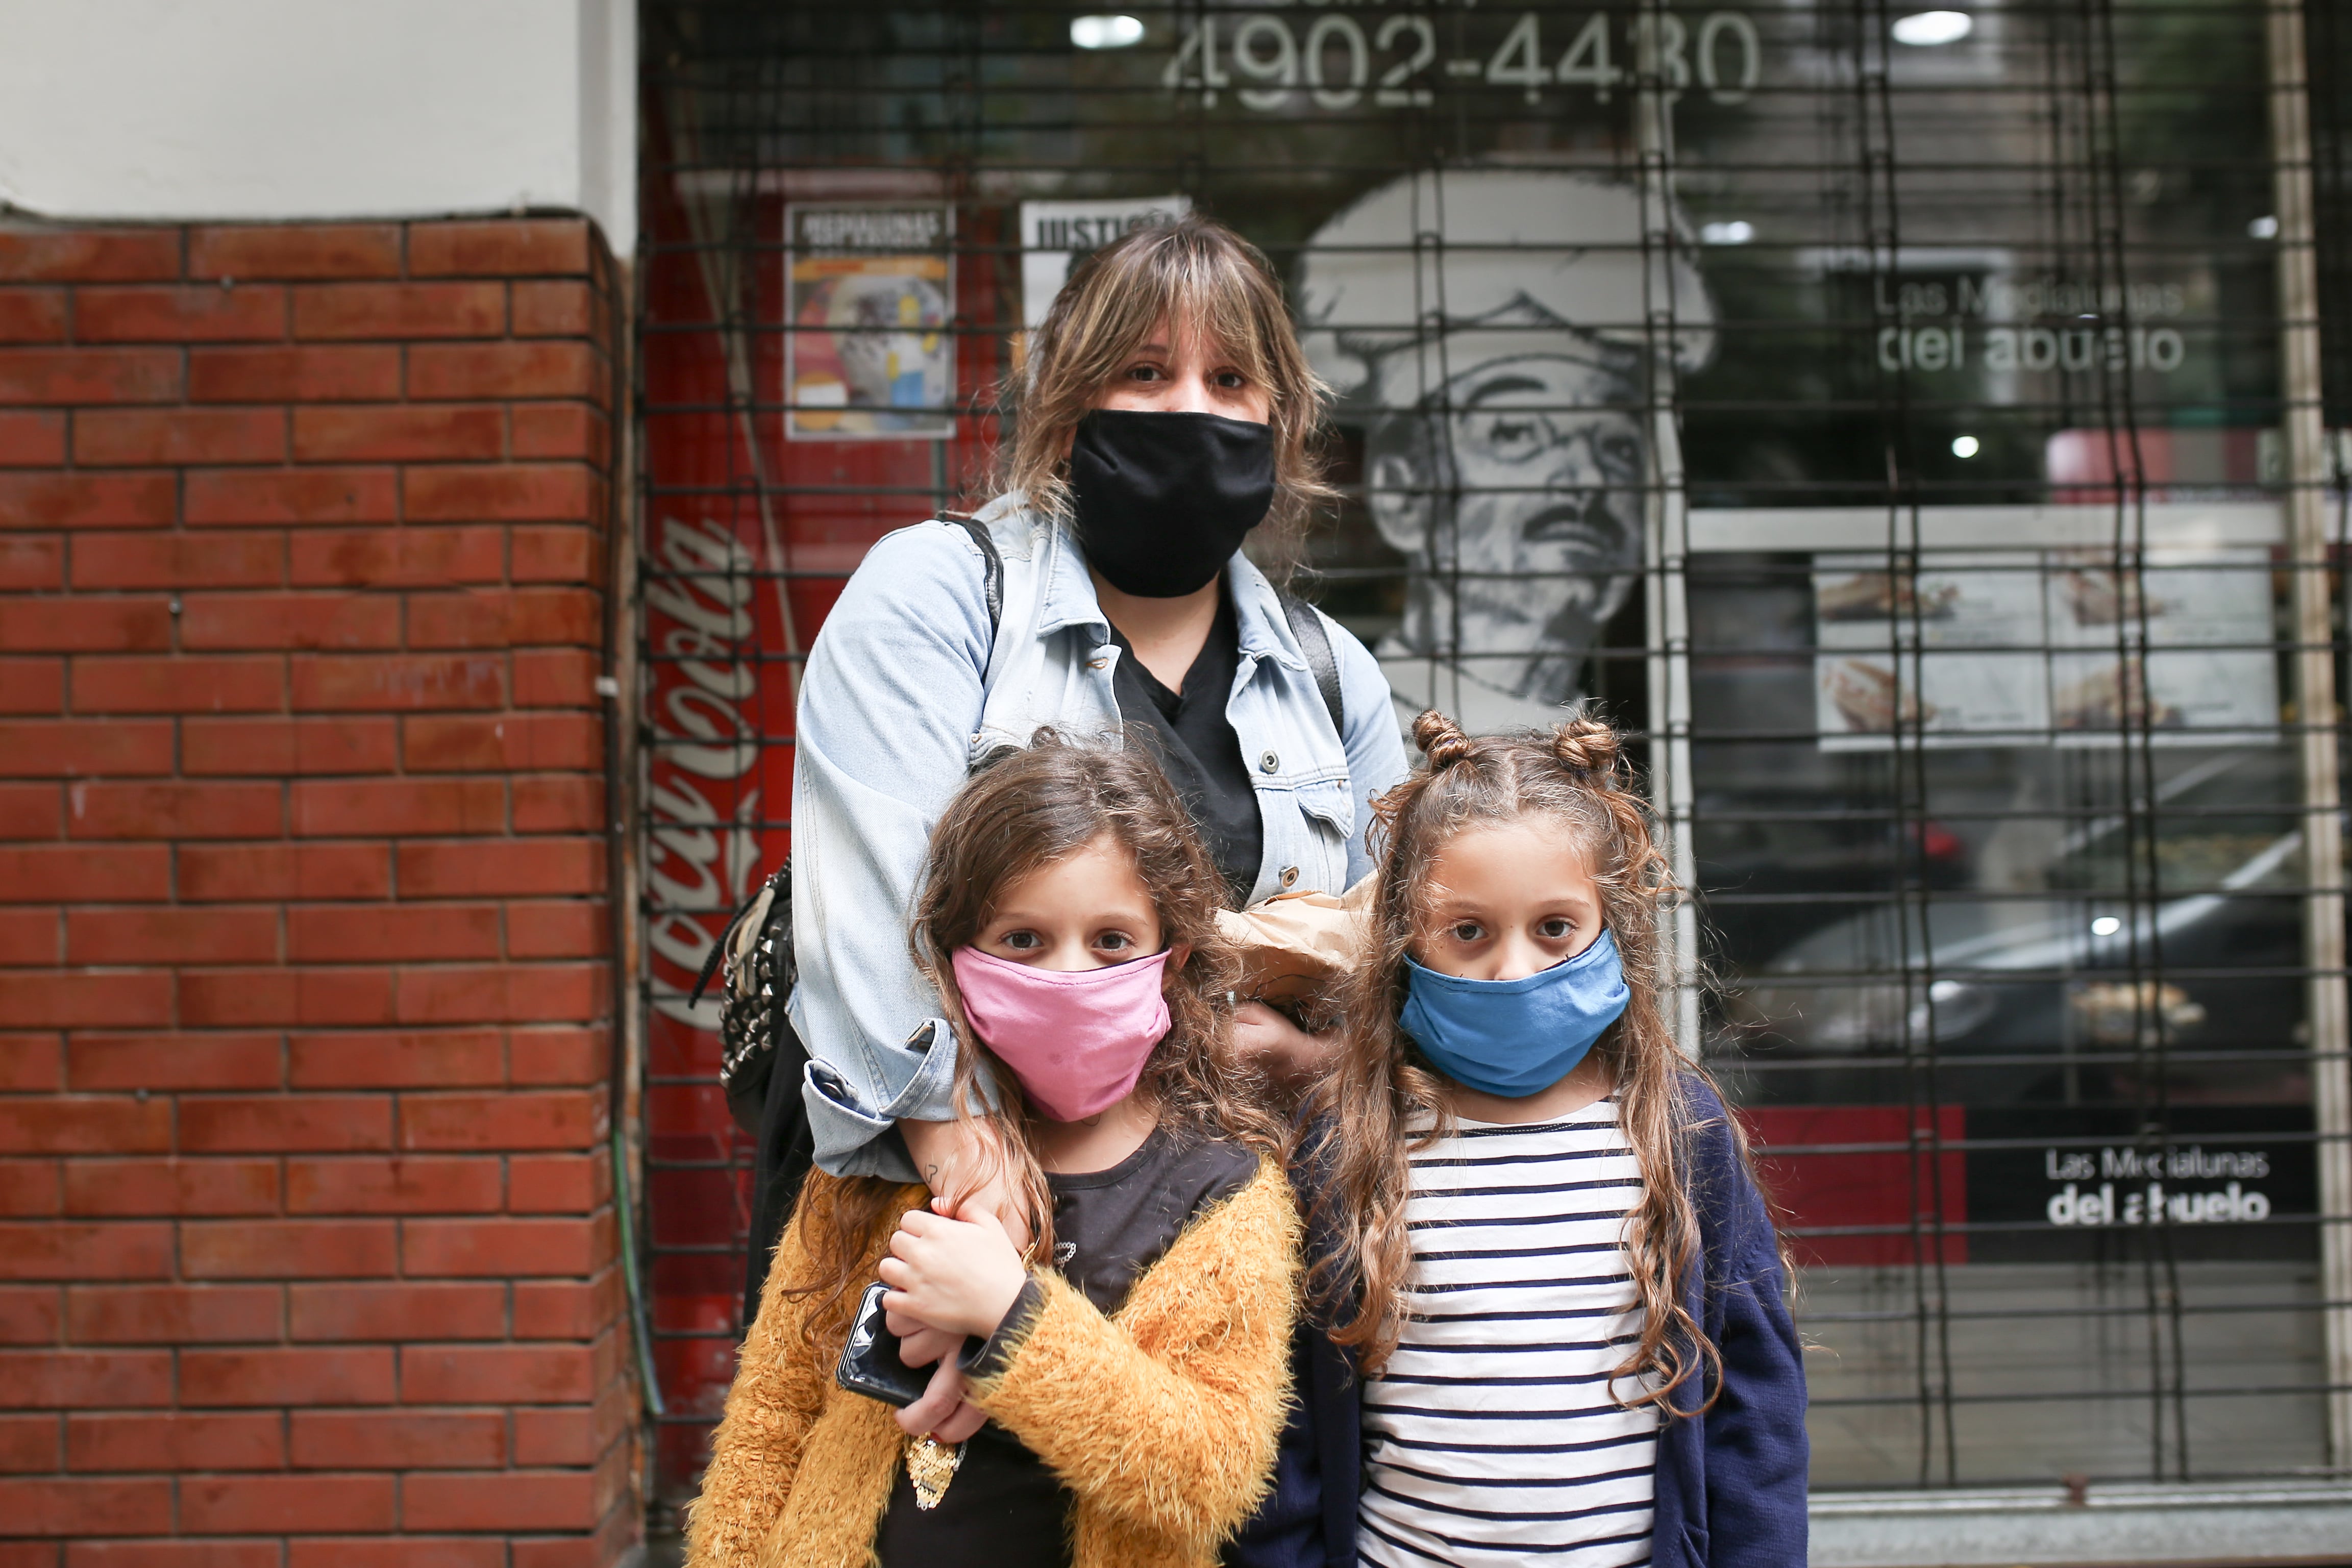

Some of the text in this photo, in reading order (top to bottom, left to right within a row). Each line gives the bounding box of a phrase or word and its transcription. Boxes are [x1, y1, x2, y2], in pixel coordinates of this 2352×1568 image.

[1161, 11, 1762, 110] 4902-4430
[1037, 210, 1176, 250] JUSTI
[1874, 273, 1948, 315] Las
[1877, 312, 1965, 372] del
[2046, 1147, 2096, 1179] Las
[2046, 1182, 2115, 1225] del
